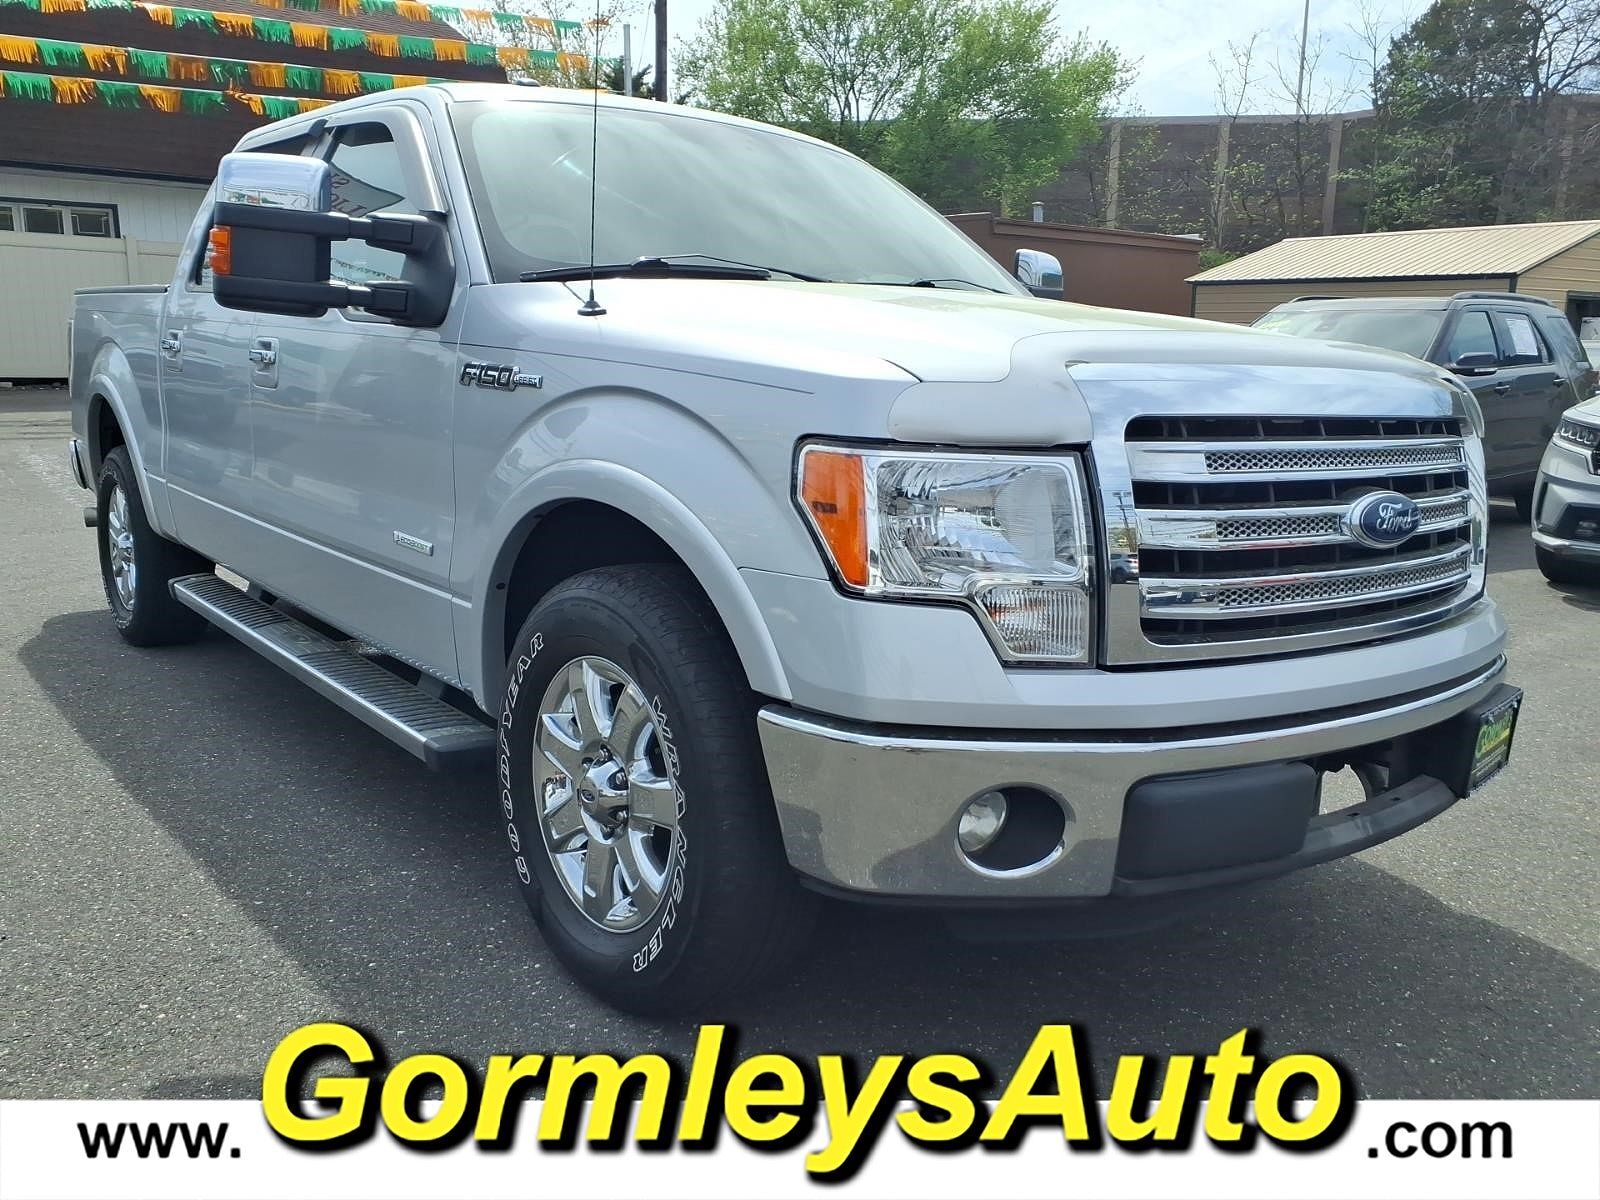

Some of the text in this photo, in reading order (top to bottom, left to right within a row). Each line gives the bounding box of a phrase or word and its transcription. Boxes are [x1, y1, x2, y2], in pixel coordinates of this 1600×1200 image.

[1376, 502, 1414, 533] Ford
[498, 631, 545, 886] GOODYEAR
[633, 694, 688, 973] WRANGLER
